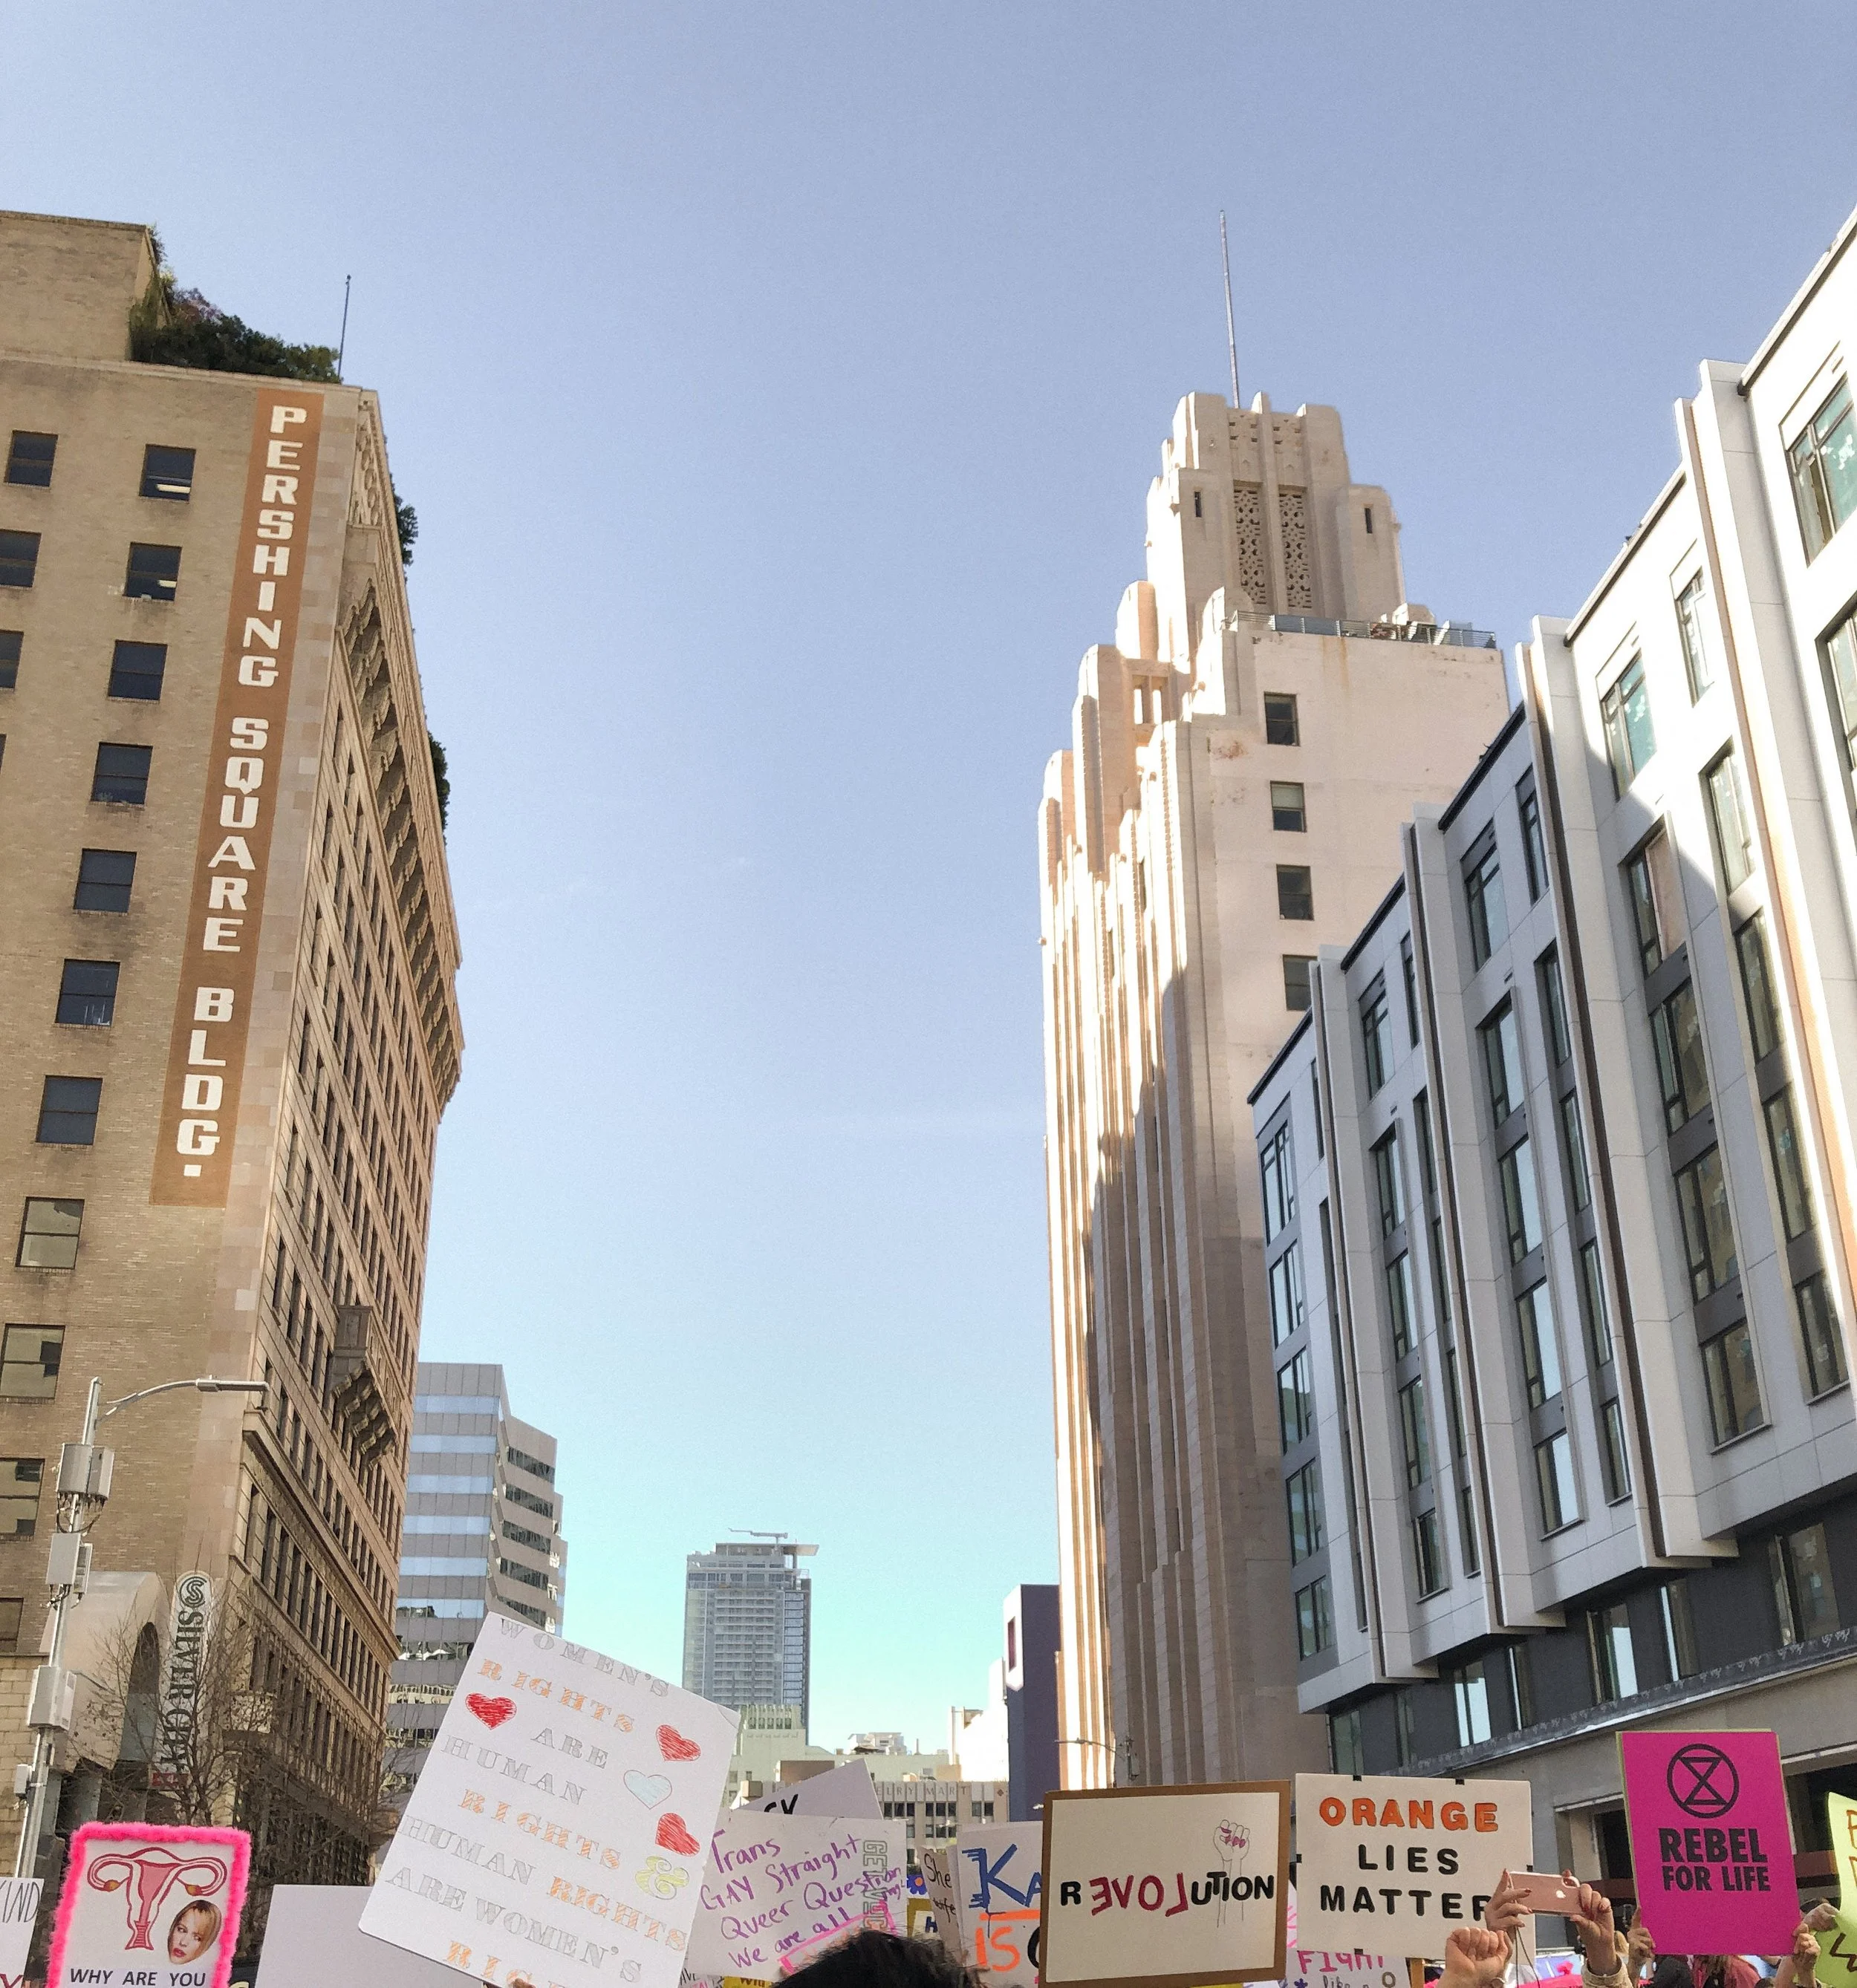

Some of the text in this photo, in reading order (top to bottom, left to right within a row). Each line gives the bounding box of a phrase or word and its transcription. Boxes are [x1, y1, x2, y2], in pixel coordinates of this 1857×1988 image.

[177, 405, 307, 1177] PERSHING SQUARE BLDG.
[168, 1610, 205, 1701] SILVER
[500, 1618, 669, 1697] WOMEN'S
[478, 1659, 636, 1734] RIGHTS
[440, 1735, 588, 1805] HUMAN
[530, 1727, 609, 1770] ARE
[926, 1785, 968, 1796] MART
[1319, 1796, 1499, 1833] ORANGE
[458, 1789, 690, 1900] RIGHTS &
[712, 1829, 781, 1874] Trans
[765, 1834, 862, 1894] Straight
[1359, 1844, 1459, 1875] LIES
[1659, 1828, 1769, 1863] REBEL
[398, 1815, 689, 1952] HUMAN RIGHTS
[924, 1853, 953, 1888] She
[1661, 1865, 1772, 1891] FOR LIFE
[0, 1880, 40, 1923] IND
[721, 1900, 793, 1940] Queer
[386, 1868, 642, 1982] ARE WOMEN'S
[728, 1906, 851, 1969] We are all
[975, 1926, 1021, 1972] IS
[71, 1968, 206, 1987] WHY ARE YOU
